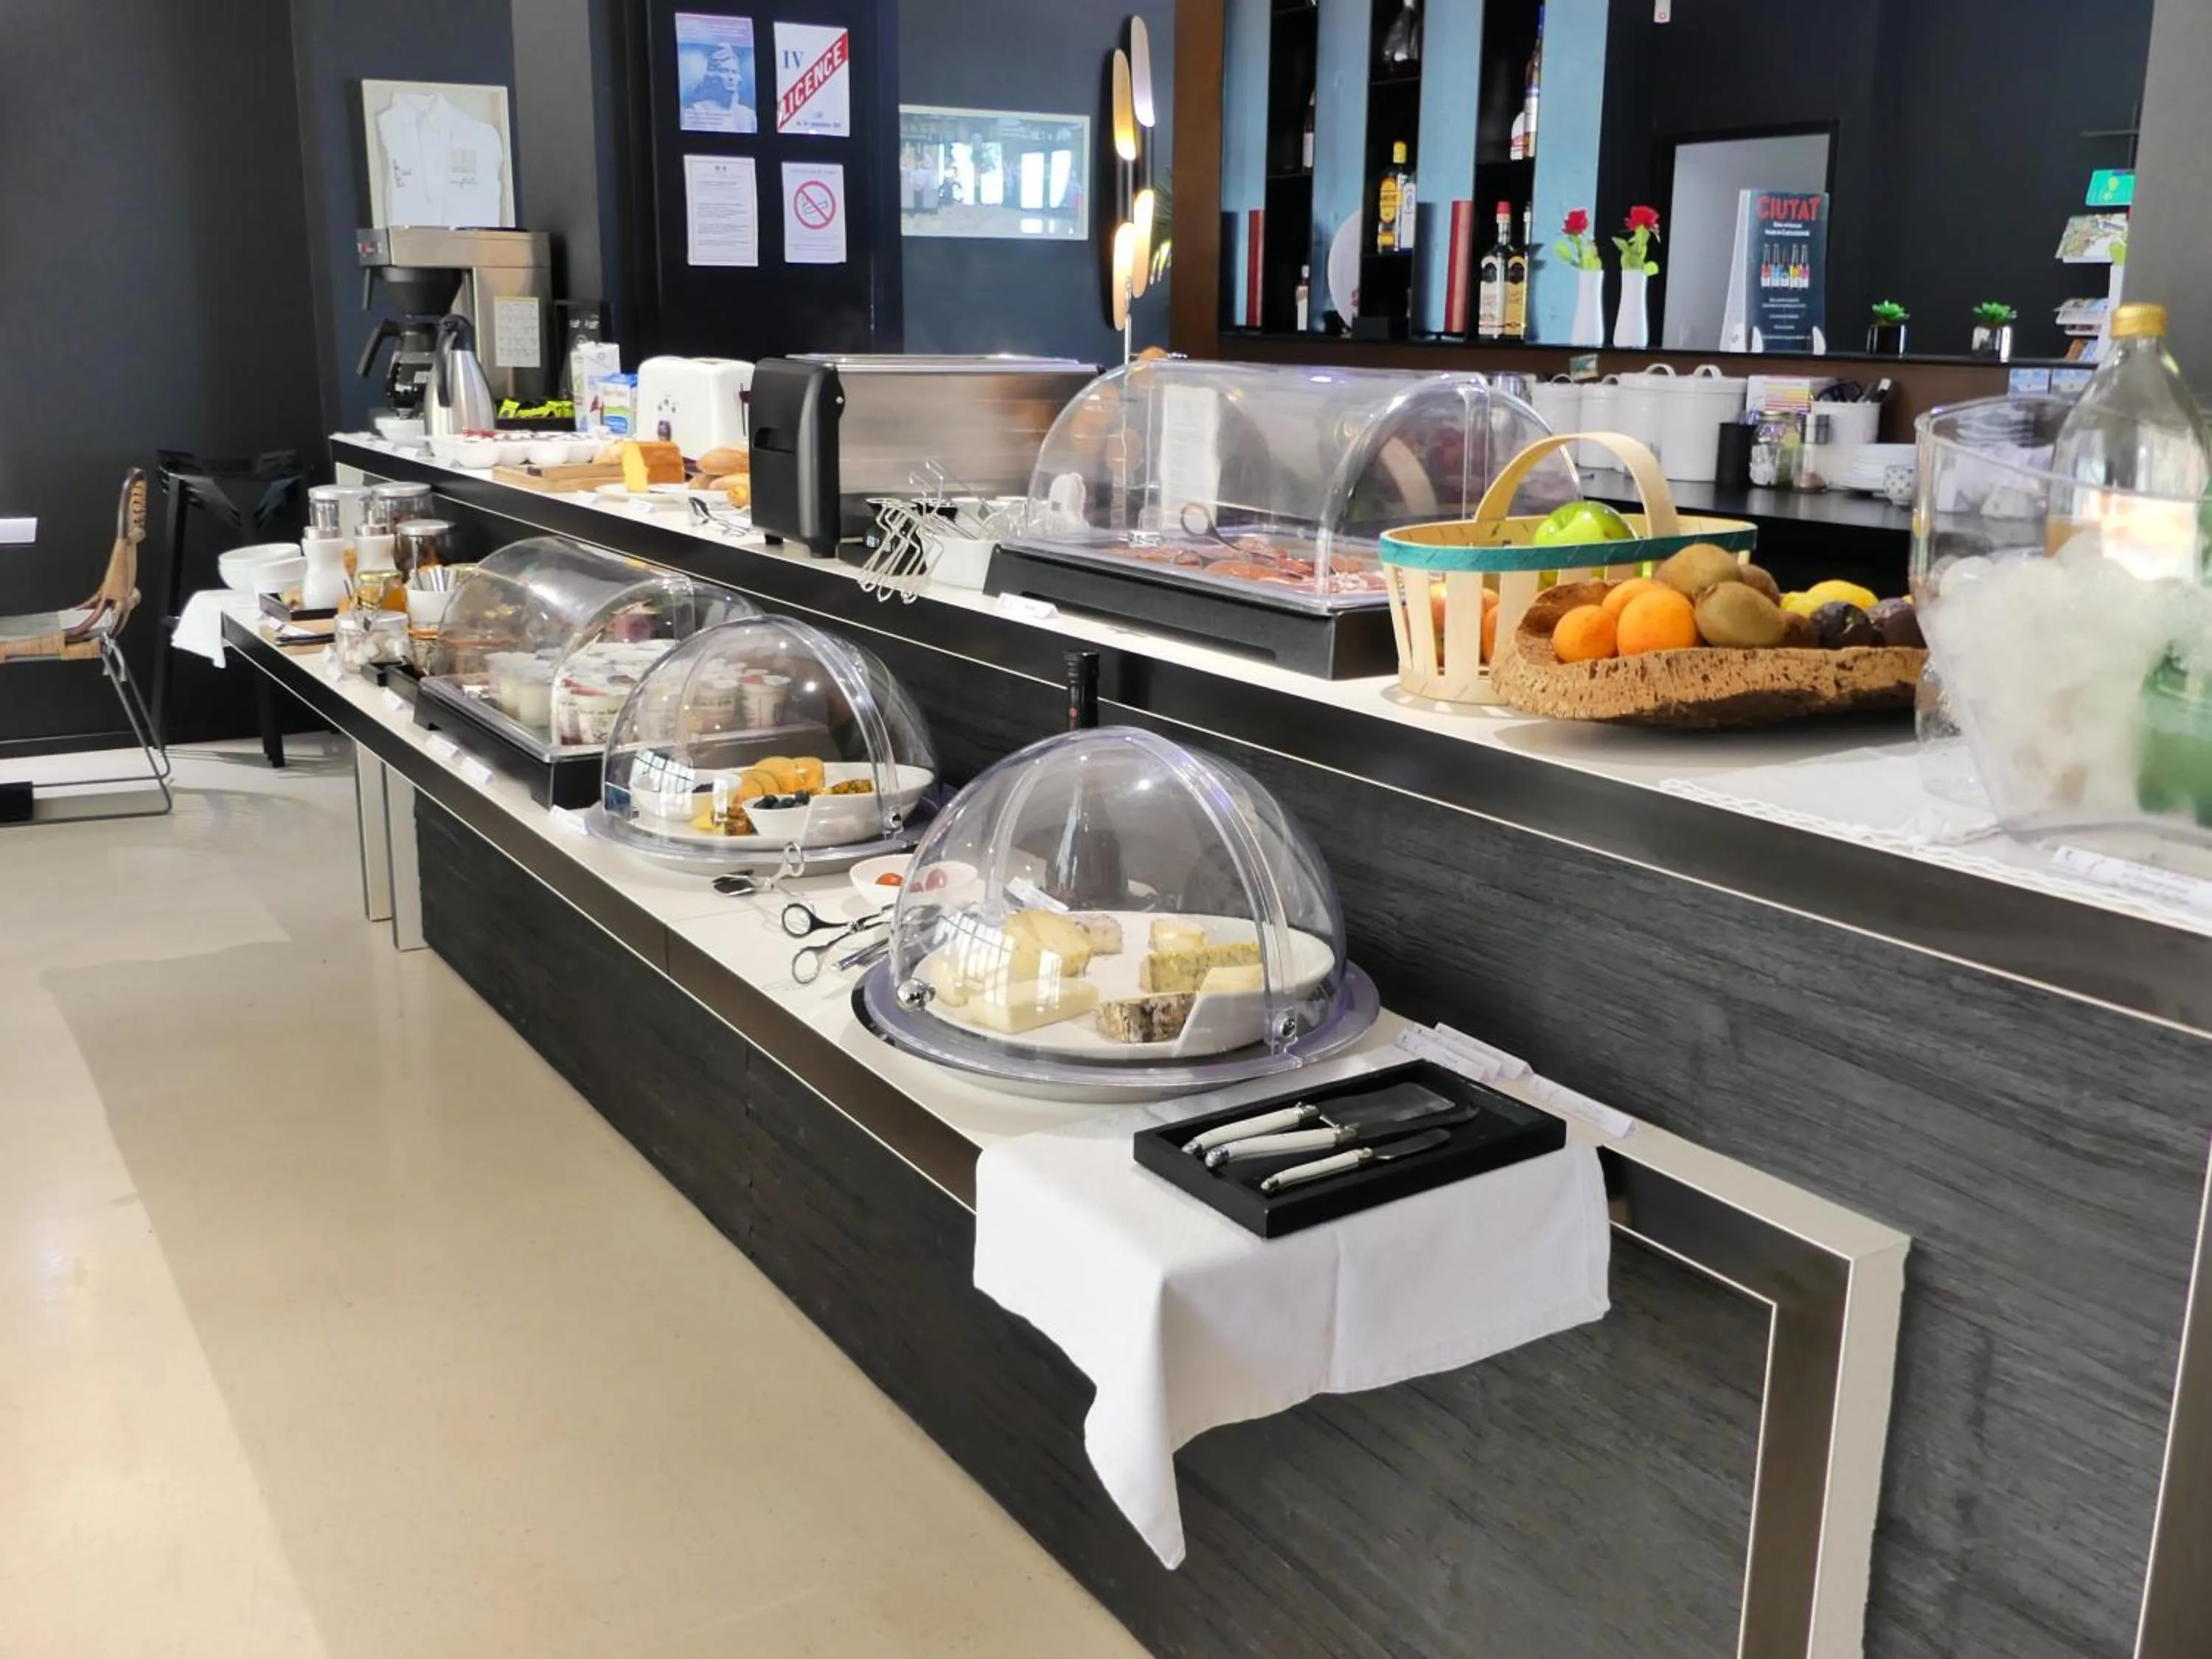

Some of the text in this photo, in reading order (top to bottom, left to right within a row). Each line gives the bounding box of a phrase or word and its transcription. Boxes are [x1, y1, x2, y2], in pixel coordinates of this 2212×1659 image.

[783, 50, 804, 69] IV
[779, 41, 843, 122] LICENCE
[1757, 195, 1821, 220] CIUTAT
